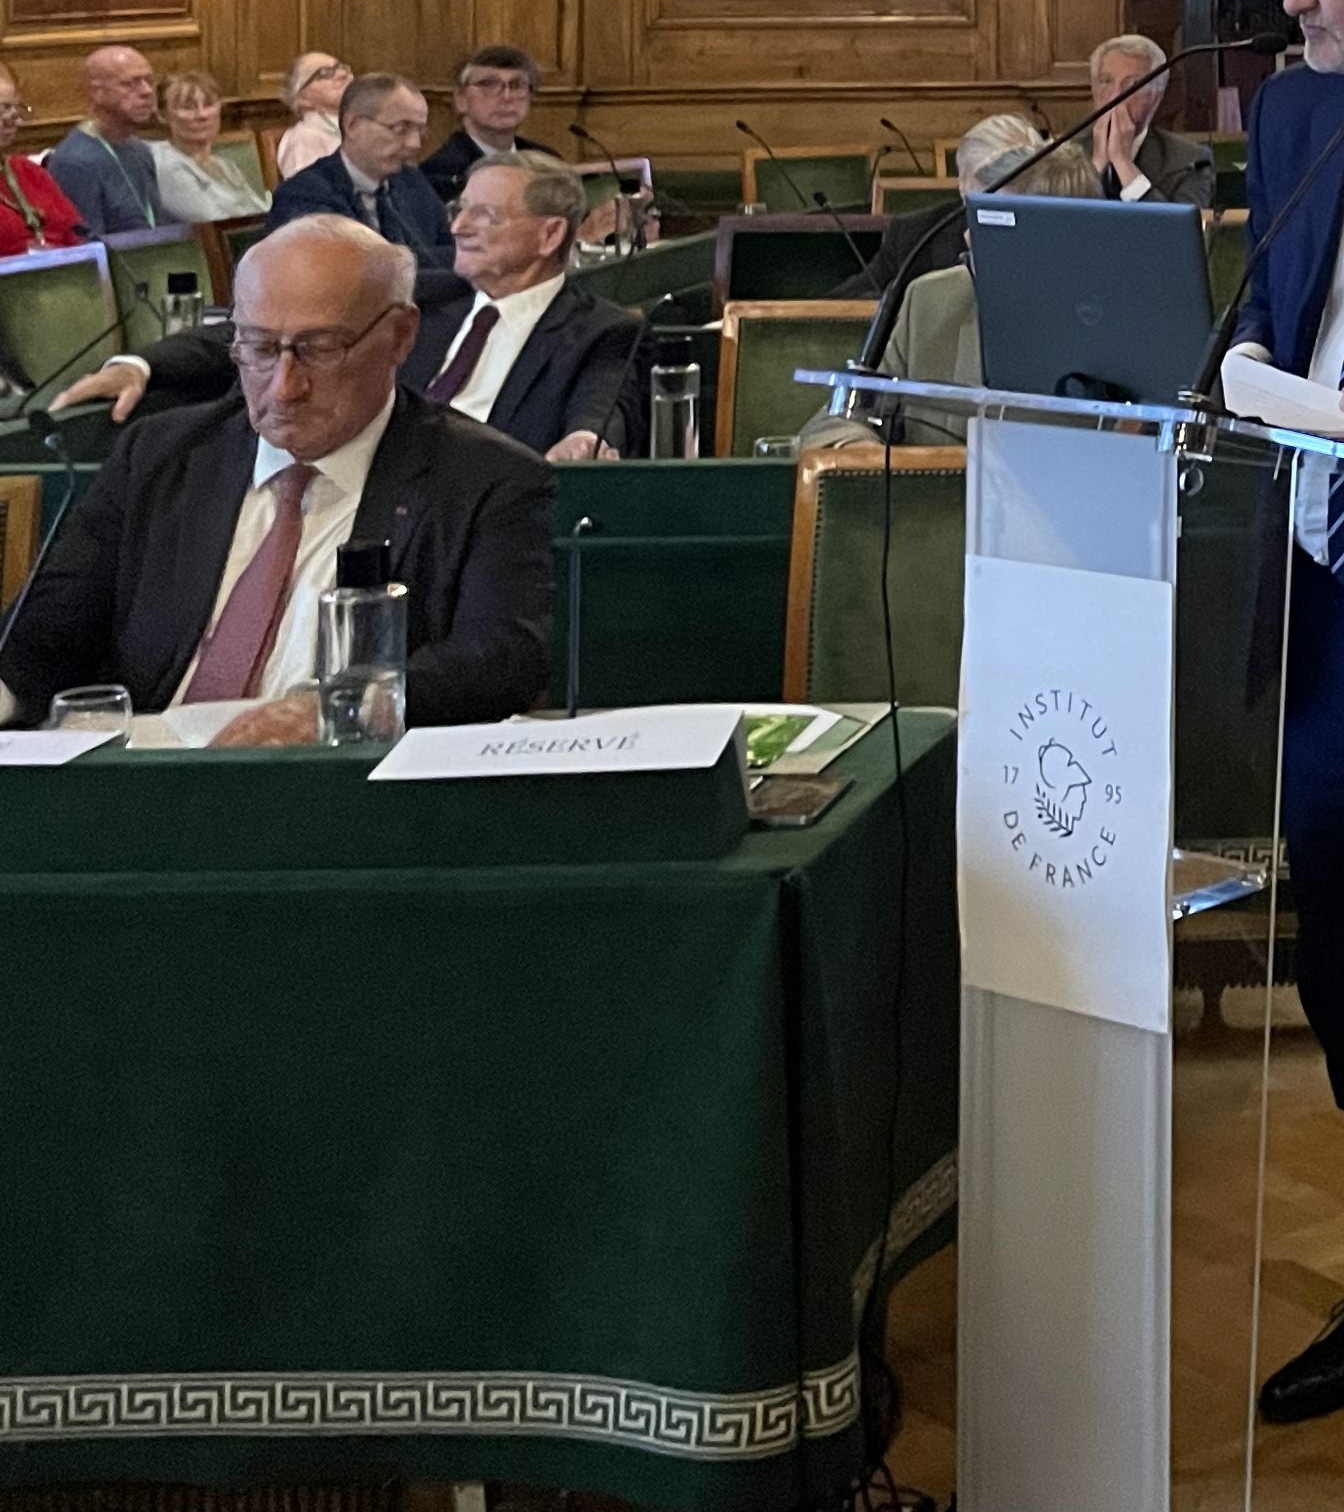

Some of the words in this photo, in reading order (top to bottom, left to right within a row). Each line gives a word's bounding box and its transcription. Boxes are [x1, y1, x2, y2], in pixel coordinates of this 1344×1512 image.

[1010, 690, 1118, 758] INSTITUT
[1003, 765, 1019, 785] 17
[1105, 784, 1122, 805] 95
[1004, 811, 1026, 851] DE
[1029, 826, 1116, 889] FRANCE
